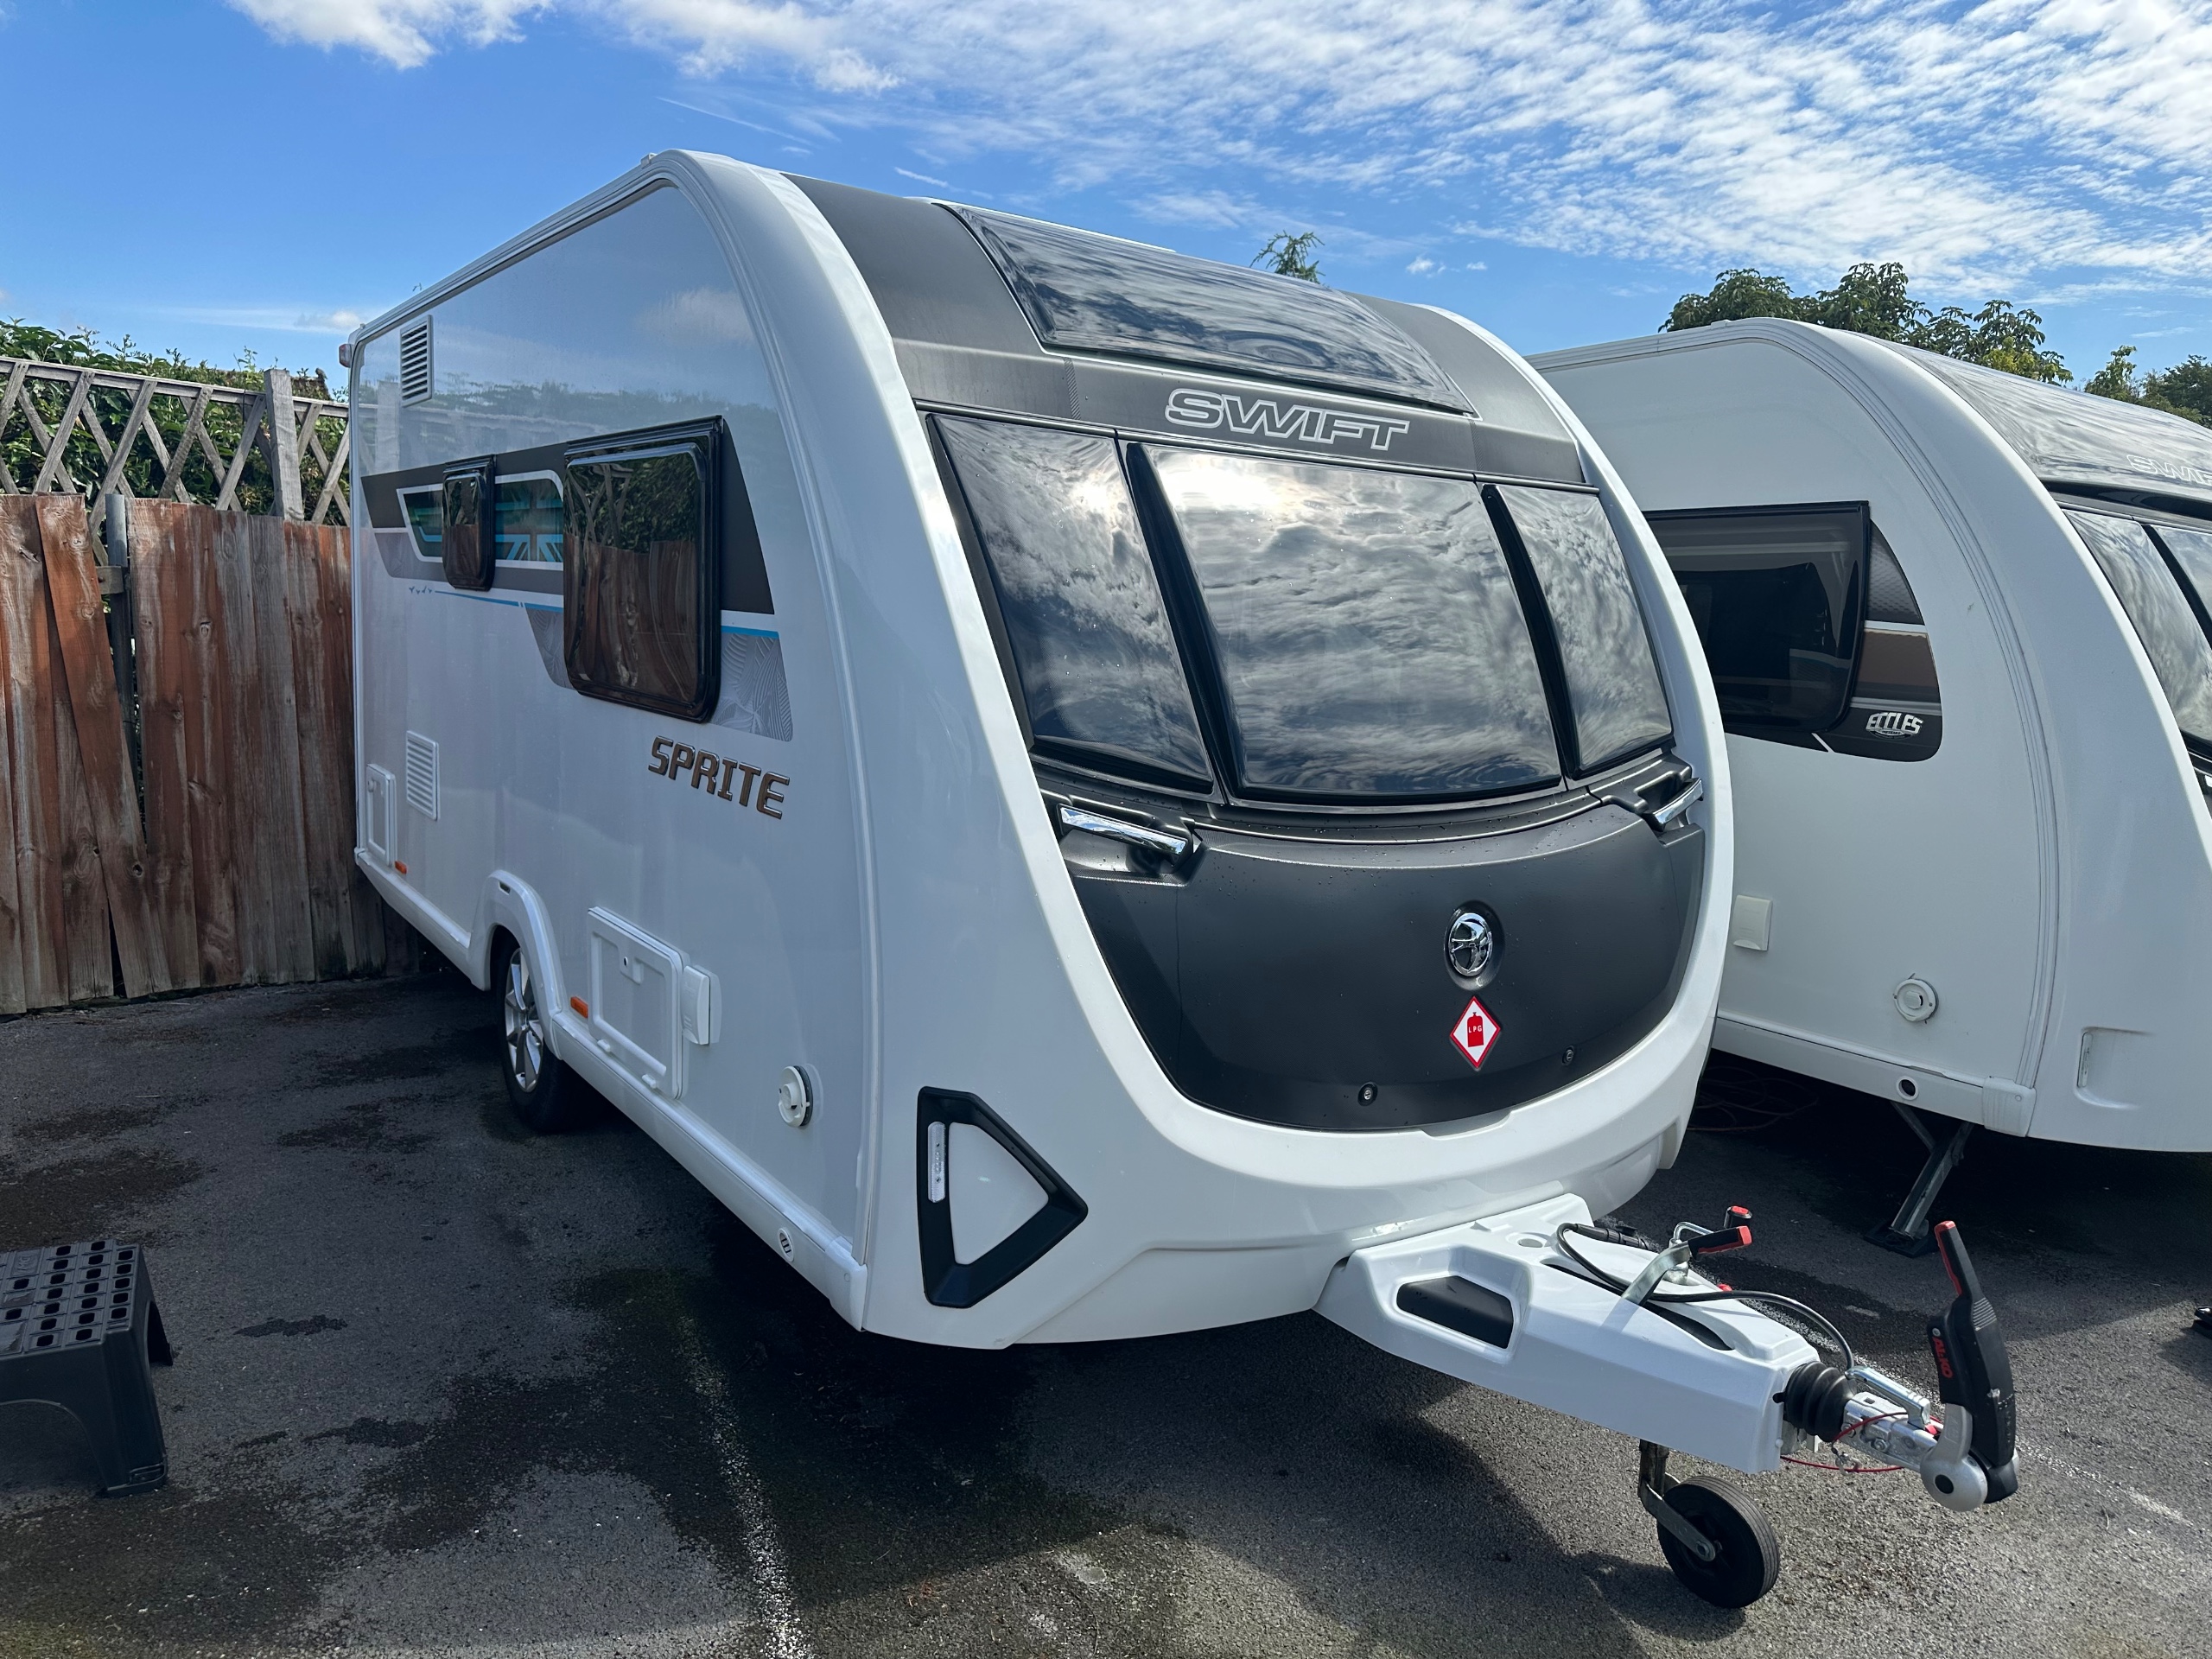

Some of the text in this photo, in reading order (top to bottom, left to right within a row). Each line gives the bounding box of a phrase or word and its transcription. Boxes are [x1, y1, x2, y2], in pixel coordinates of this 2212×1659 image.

[1165, 388, 1410, 451] SWIFT
[1866, 712, 1923, 734] ECCLES
[648, 735, 790, 820] SPRITE
[1468, 1025, 1483, 1033] LPG
